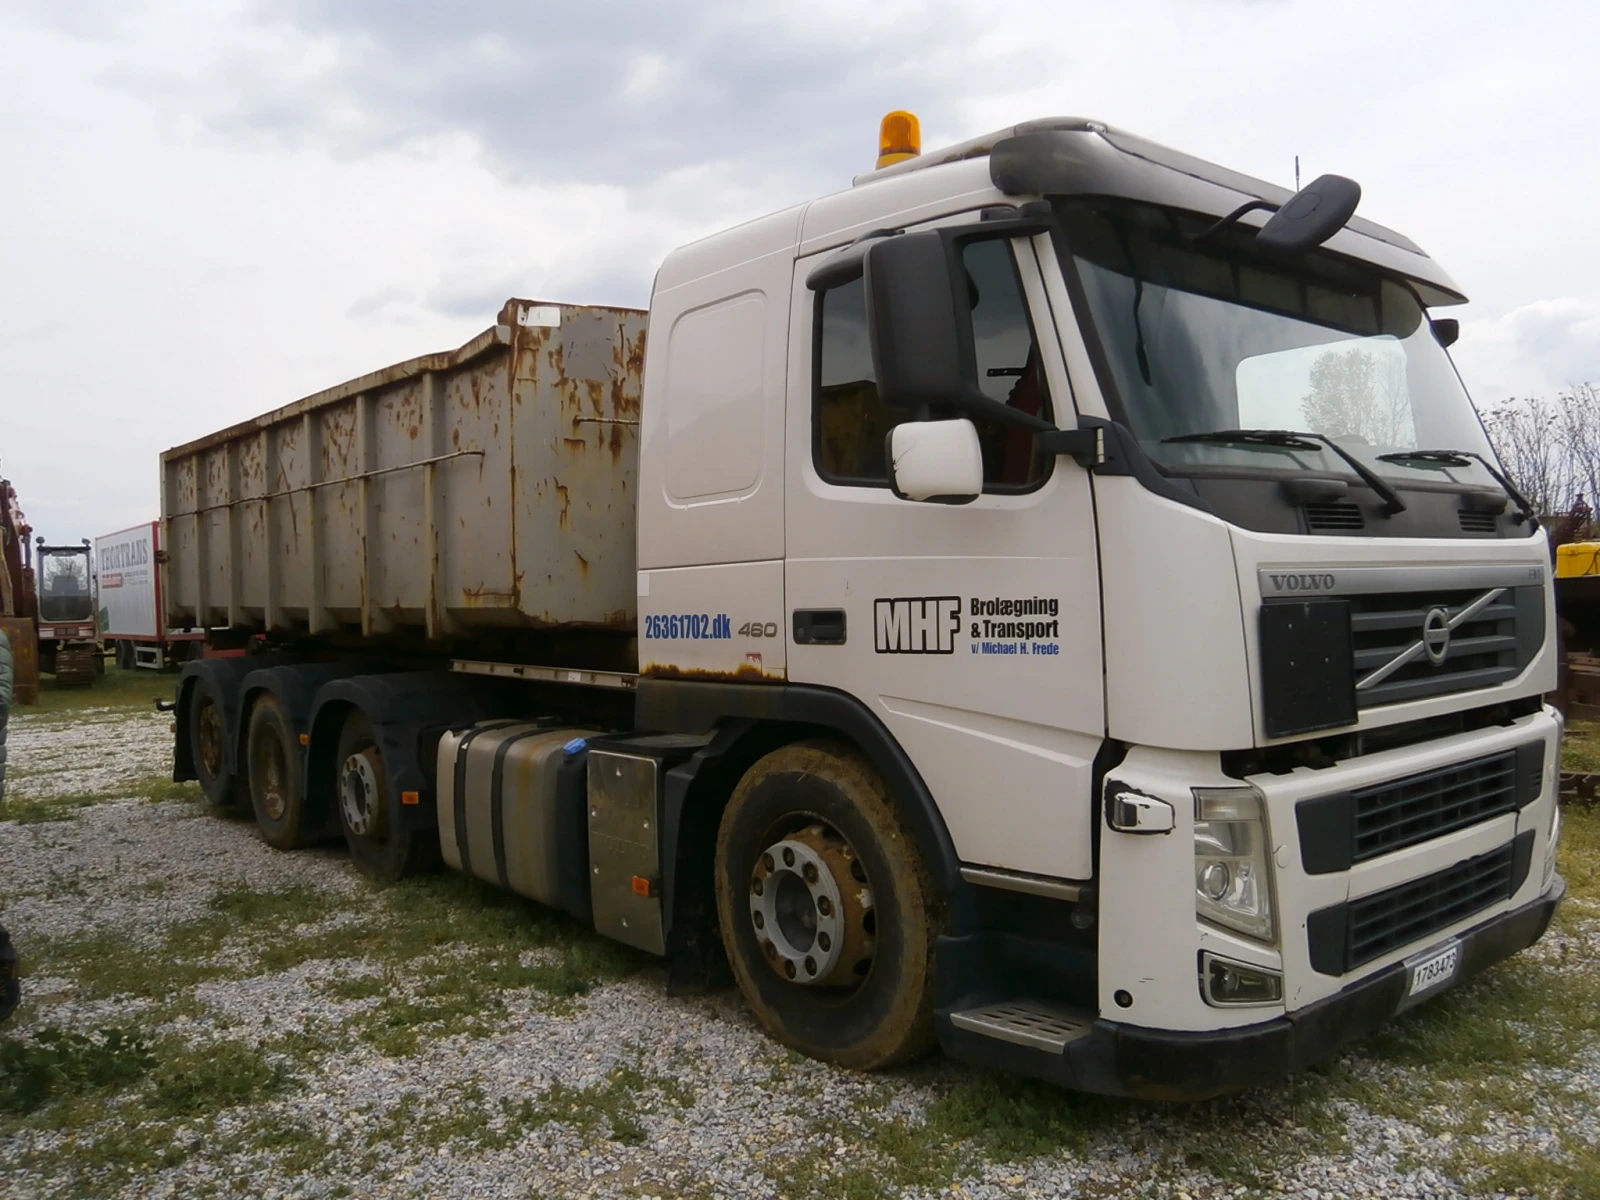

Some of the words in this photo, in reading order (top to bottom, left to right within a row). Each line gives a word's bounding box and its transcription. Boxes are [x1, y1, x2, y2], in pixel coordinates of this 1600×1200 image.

[1269, 574, 1335, 591] VOLVO
[970, 596, 1059, 617] Brolægning
[645, 614, 731, 639] 26361702.dk
[738, 622, 777, 638] 460
[874, 596, 961, 654] MHF
[970, 622, 981, 638] &
[982, 619, 1059, 640] Transport
[982, 642, 1018, 655] Michael
[1020, 642, 1029, 655] H.
[1032, 642, 1060, 655] Frede
